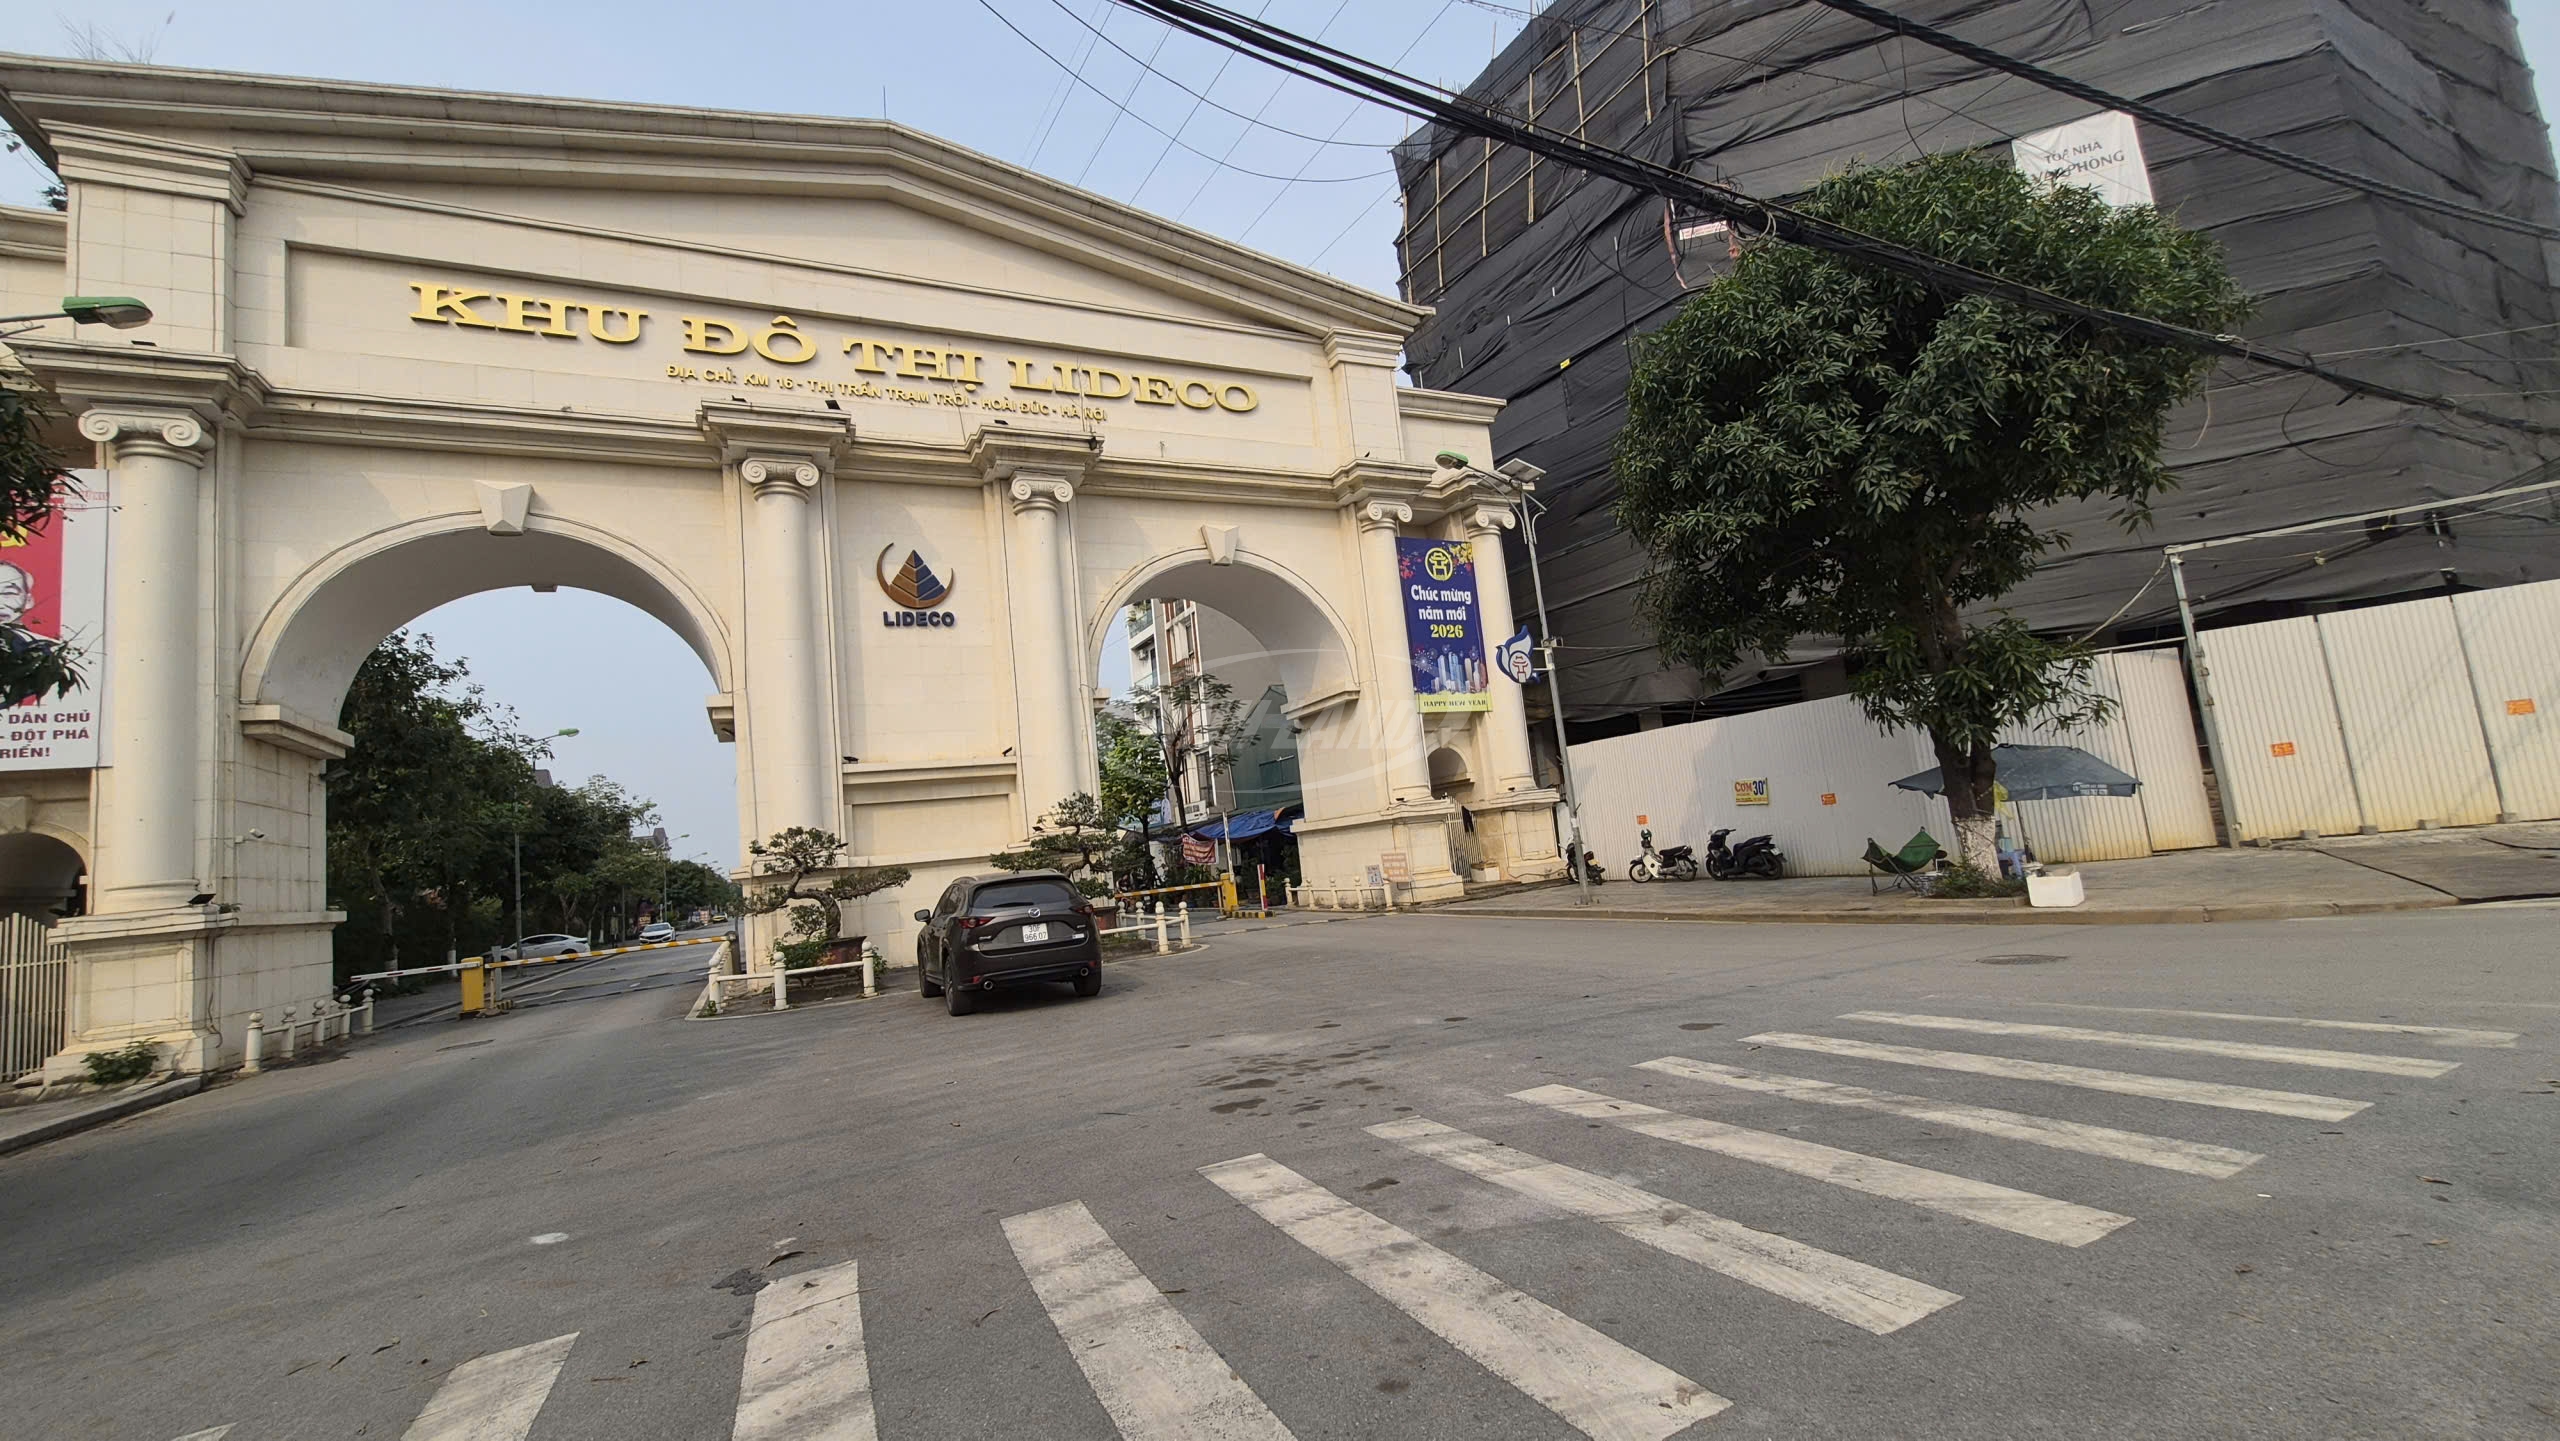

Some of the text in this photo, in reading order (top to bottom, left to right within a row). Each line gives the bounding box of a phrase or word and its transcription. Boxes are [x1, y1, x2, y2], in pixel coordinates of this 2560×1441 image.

[408, 281, 1260, 413] KHU ĐÔ THỊ LIDECO
[665, 364, 698, 383] ĐỊA
[744, 373, 770, 388] KM
[777, 376, 794, 390] 16
[807, 379, 834, 398] THỊ
[838, 380, 882, 399] TRẤN
[886, 387, 930, 407] TRẠM
[982, 396, 1017, 413] HOÀI
[1060, 404, 1081, 419] HÀ
[1411, 584, 1472, 605] Chúc mừng
[883, 611, 955, 627] LIDECO
[1418, 605, 1467, 621] năm mới
[1430, 624, 1464, 639] 2026
[8, 709, 91, 724] DÂN CHỦ
[11, 728, 47, 743] ĐỘT
[52, 726, 90, 740] PHÁ
